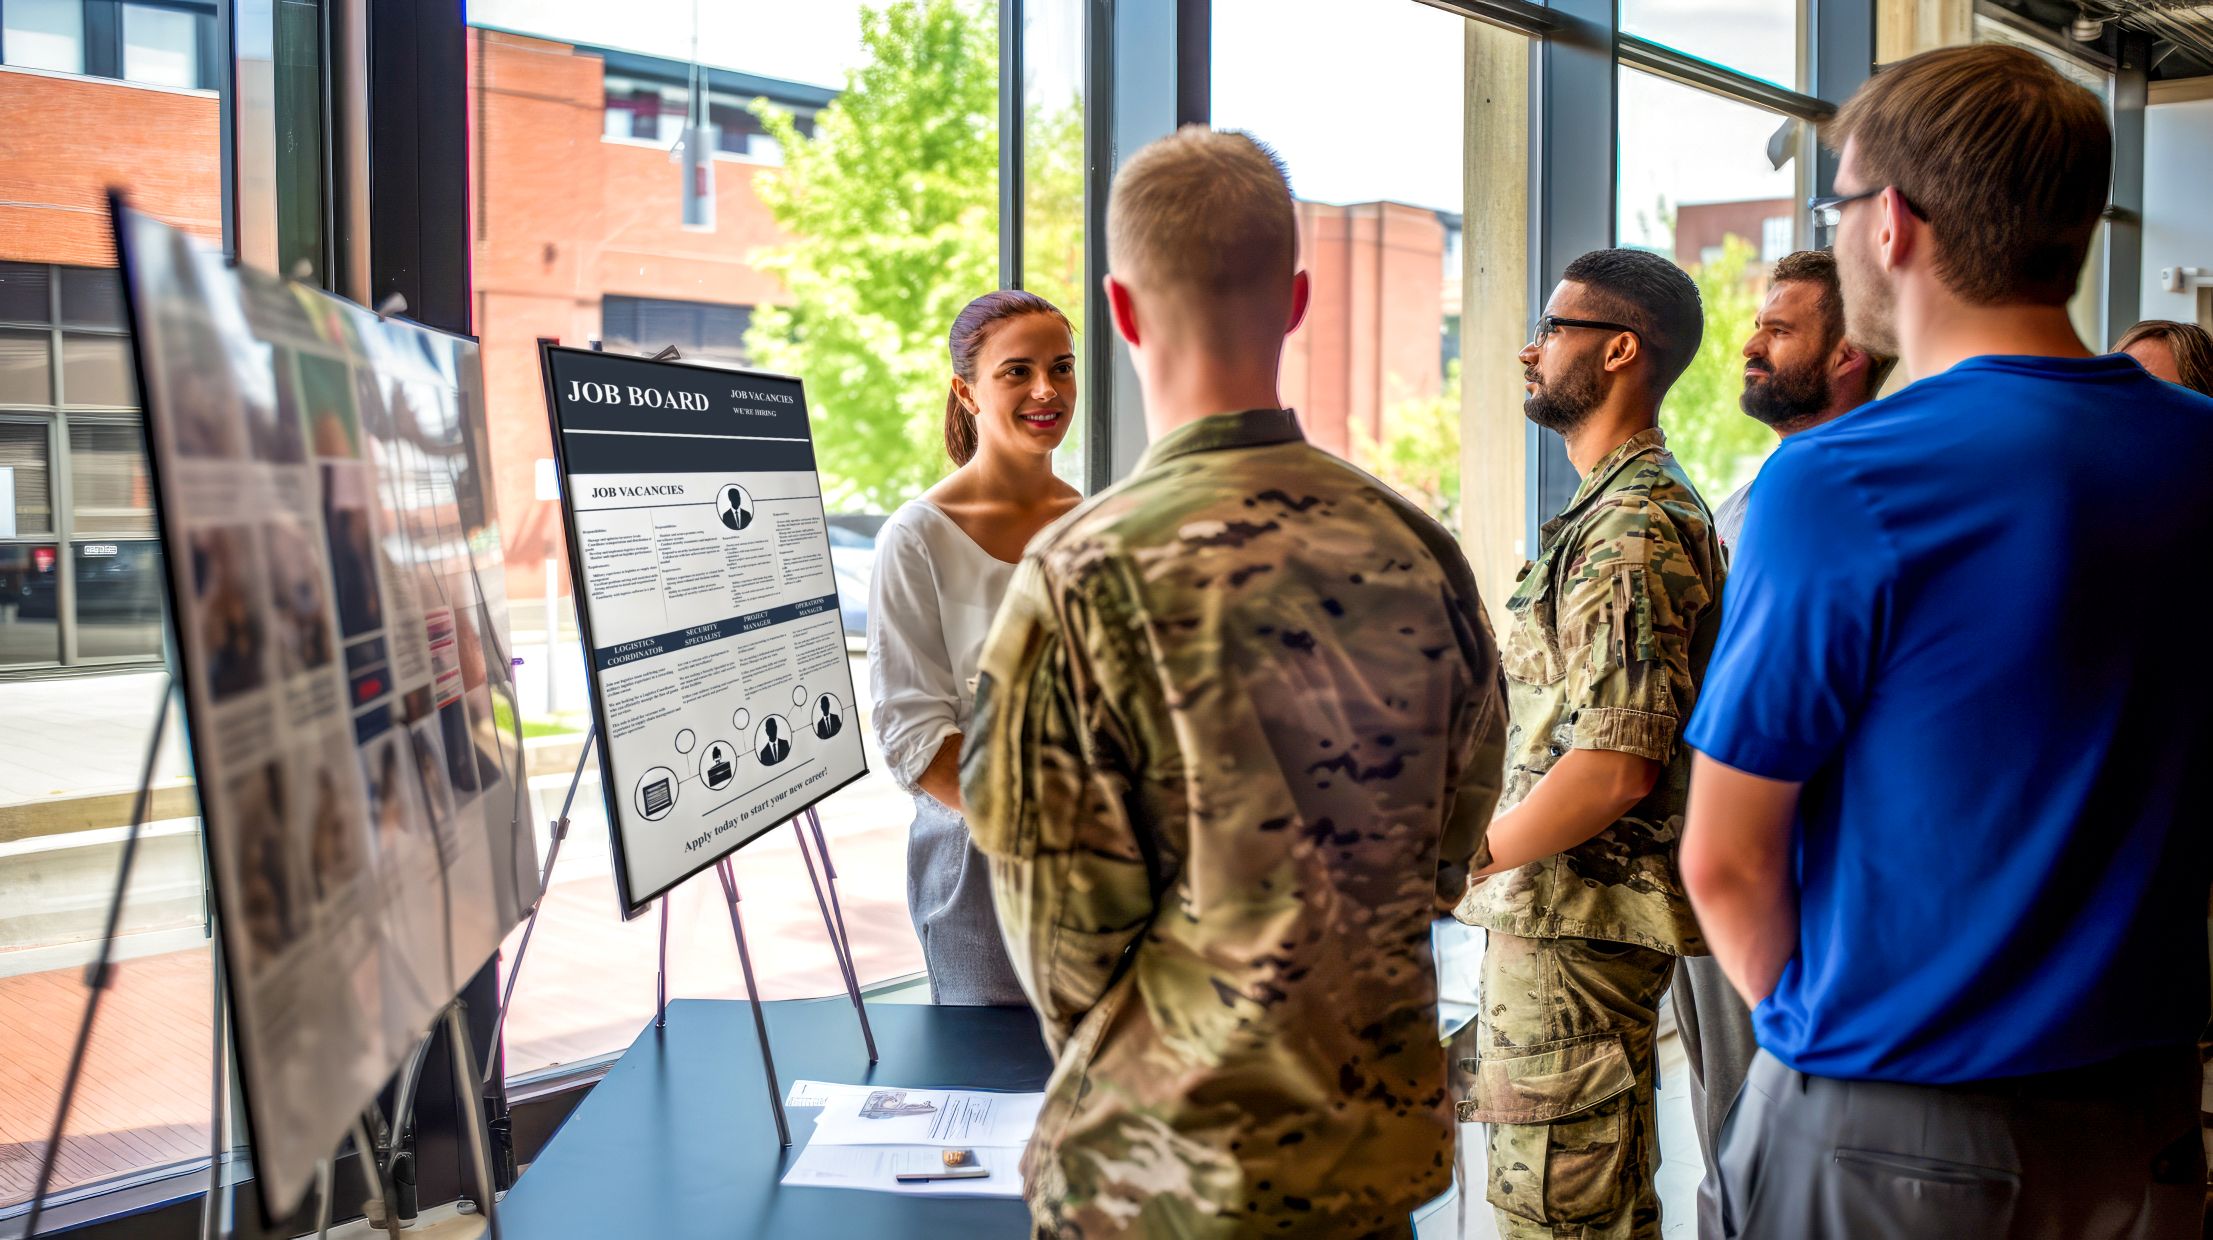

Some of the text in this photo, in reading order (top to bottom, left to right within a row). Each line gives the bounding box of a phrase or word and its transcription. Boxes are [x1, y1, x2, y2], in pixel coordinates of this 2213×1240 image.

[568, 380, 709, 411] JOB BOARD
[731, 389, 794, 404] JOB VACANCIES
[733, 407, 777, 417] WE'RE HIRING
[592, 485, 684, 499] JOB VACANCIES
[795, 598, 825, 610] OPERATIONS
[743, 611, 769, 623] PROJECT
[799, 606, 824, 617] MANAGER
[686, 623, 718, 637] SECURITY
[743, 619, 772, 631] MANAGER
[684, 631, 721, 646] SPECIALIST
[614, 638, 655, 654] LOGISTICS
[607, 646, 664, 666] COORDINATOR
[684, 766, 828, 853] Apply today to start your new career!
